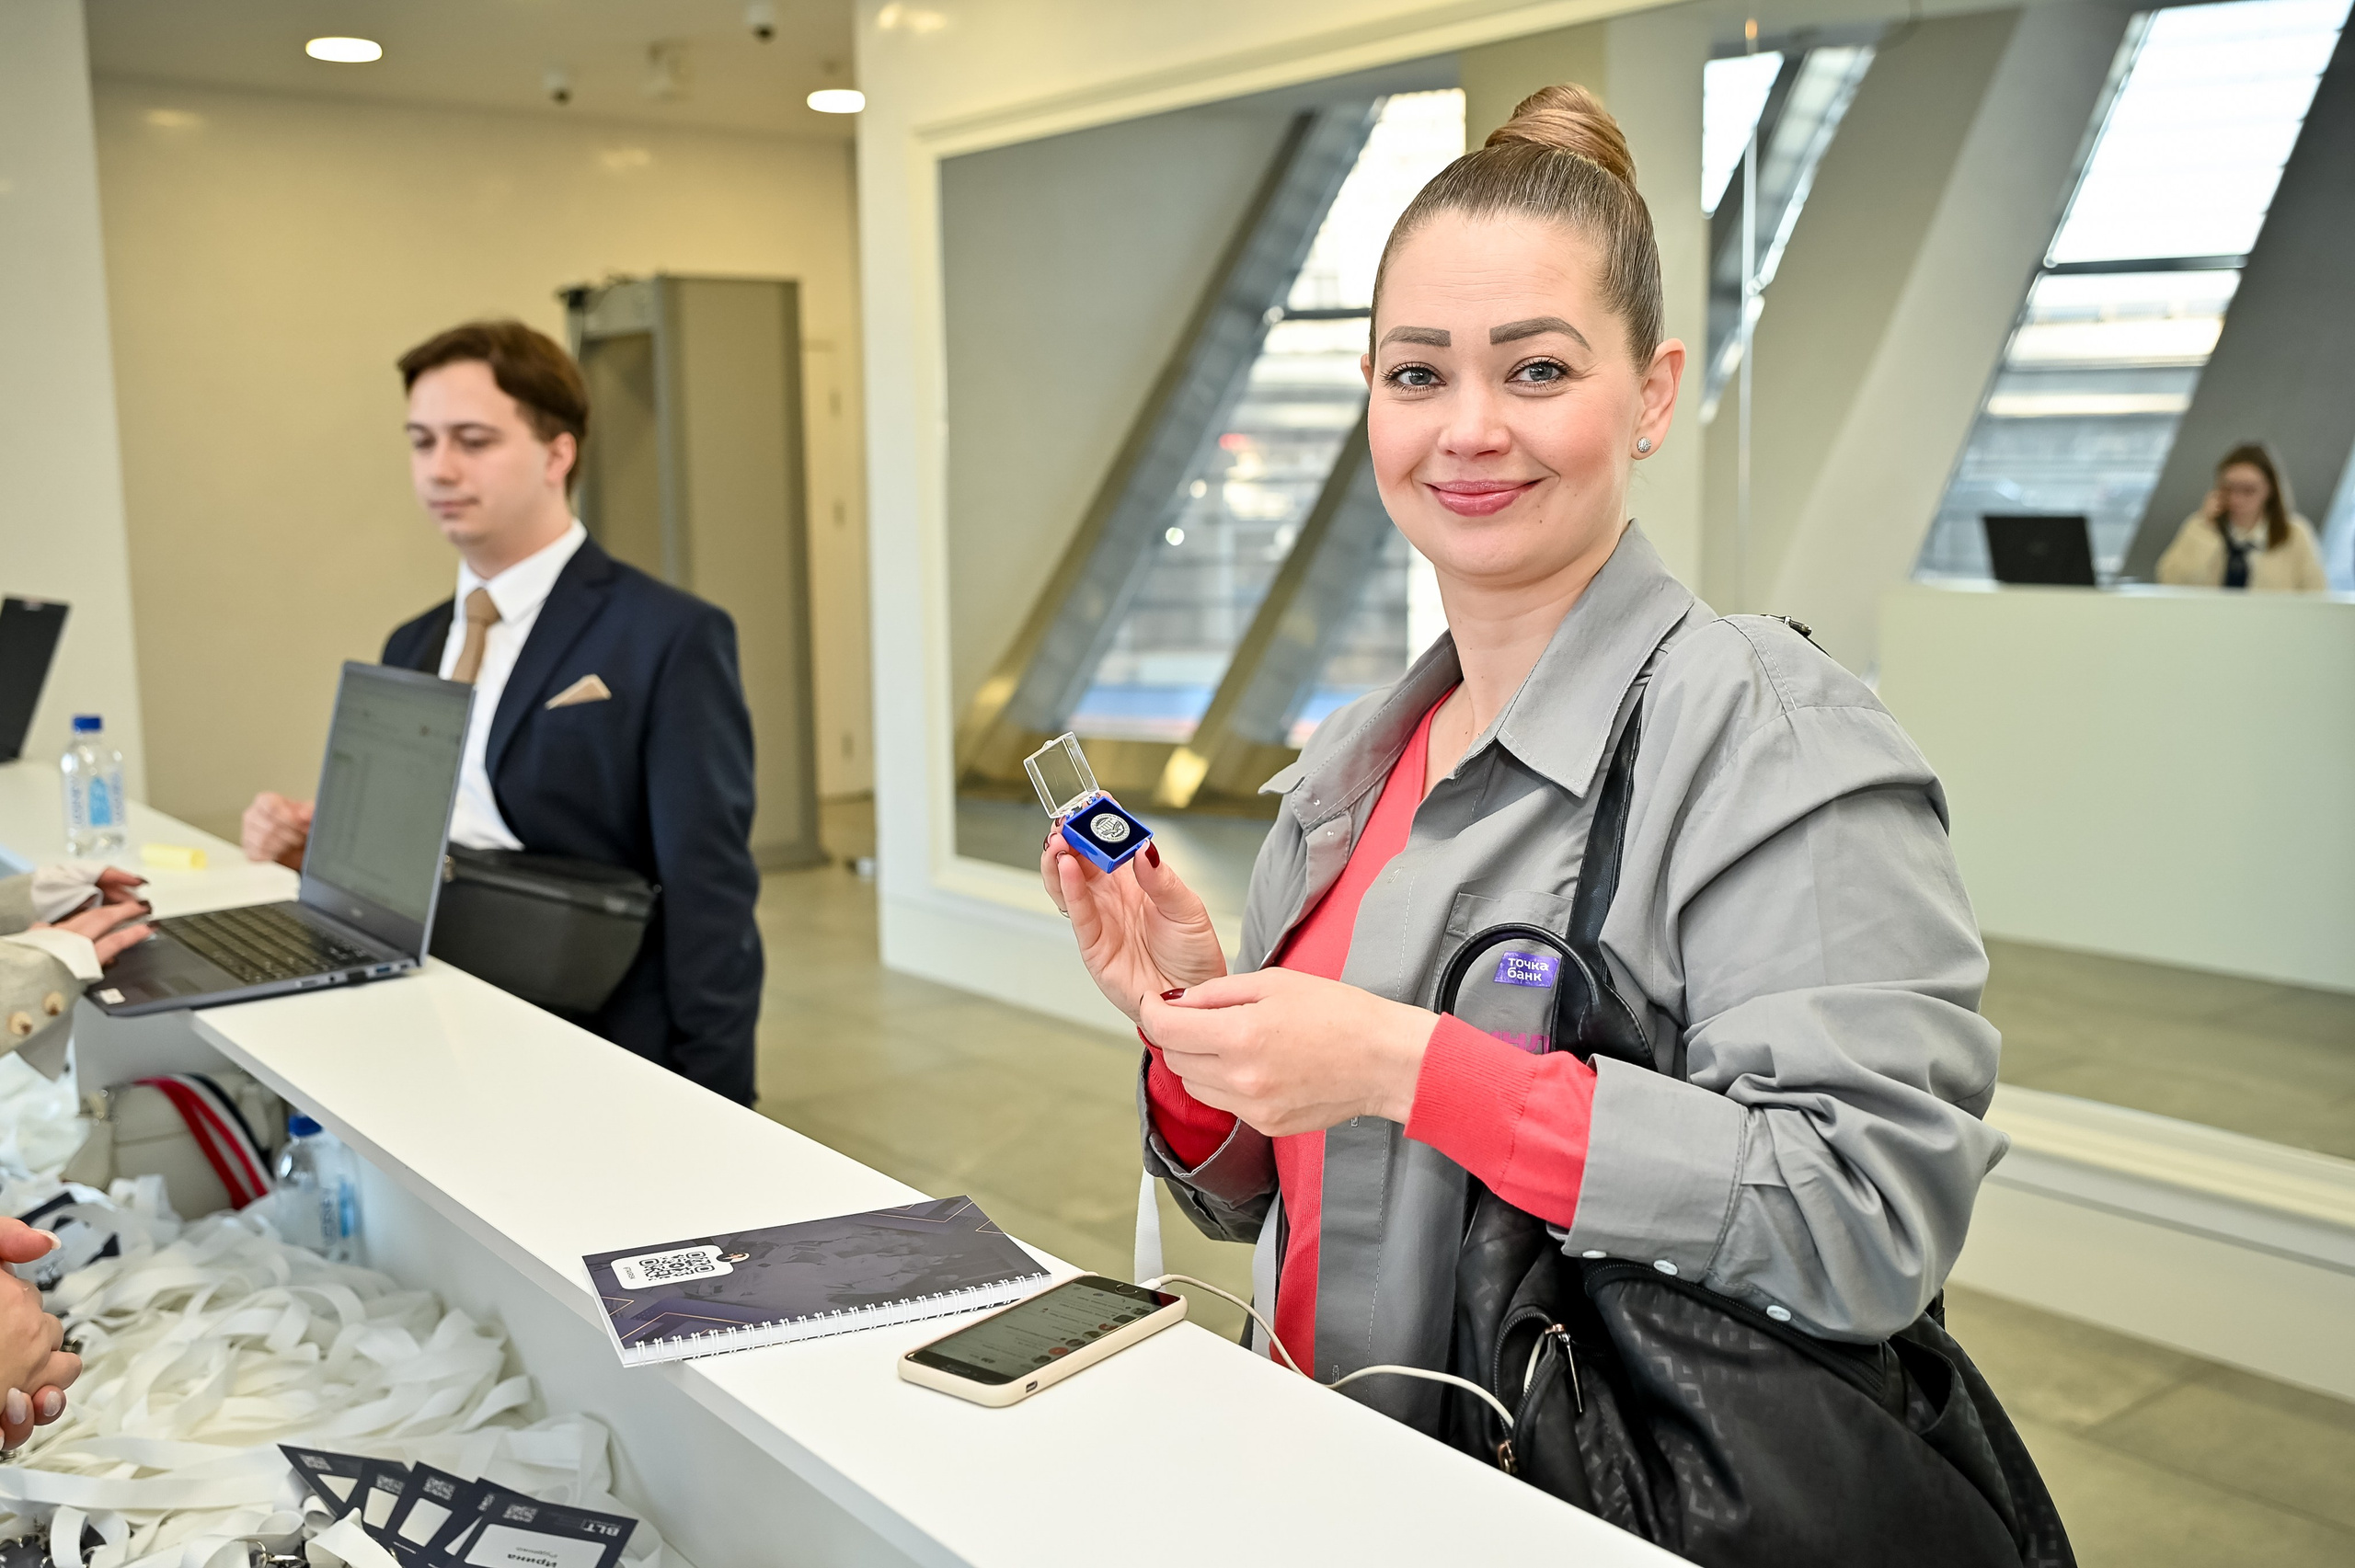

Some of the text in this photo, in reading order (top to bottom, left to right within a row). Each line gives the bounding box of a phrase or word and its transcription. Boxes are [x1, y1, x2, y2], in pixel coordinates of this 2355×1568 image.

[1508, 957, 1549, 971] точка
[1507, 967, 1543, 982] банк
[583, 1523, 620, 1537] BLT
[507, 1553, 557, 1568] Ирина
